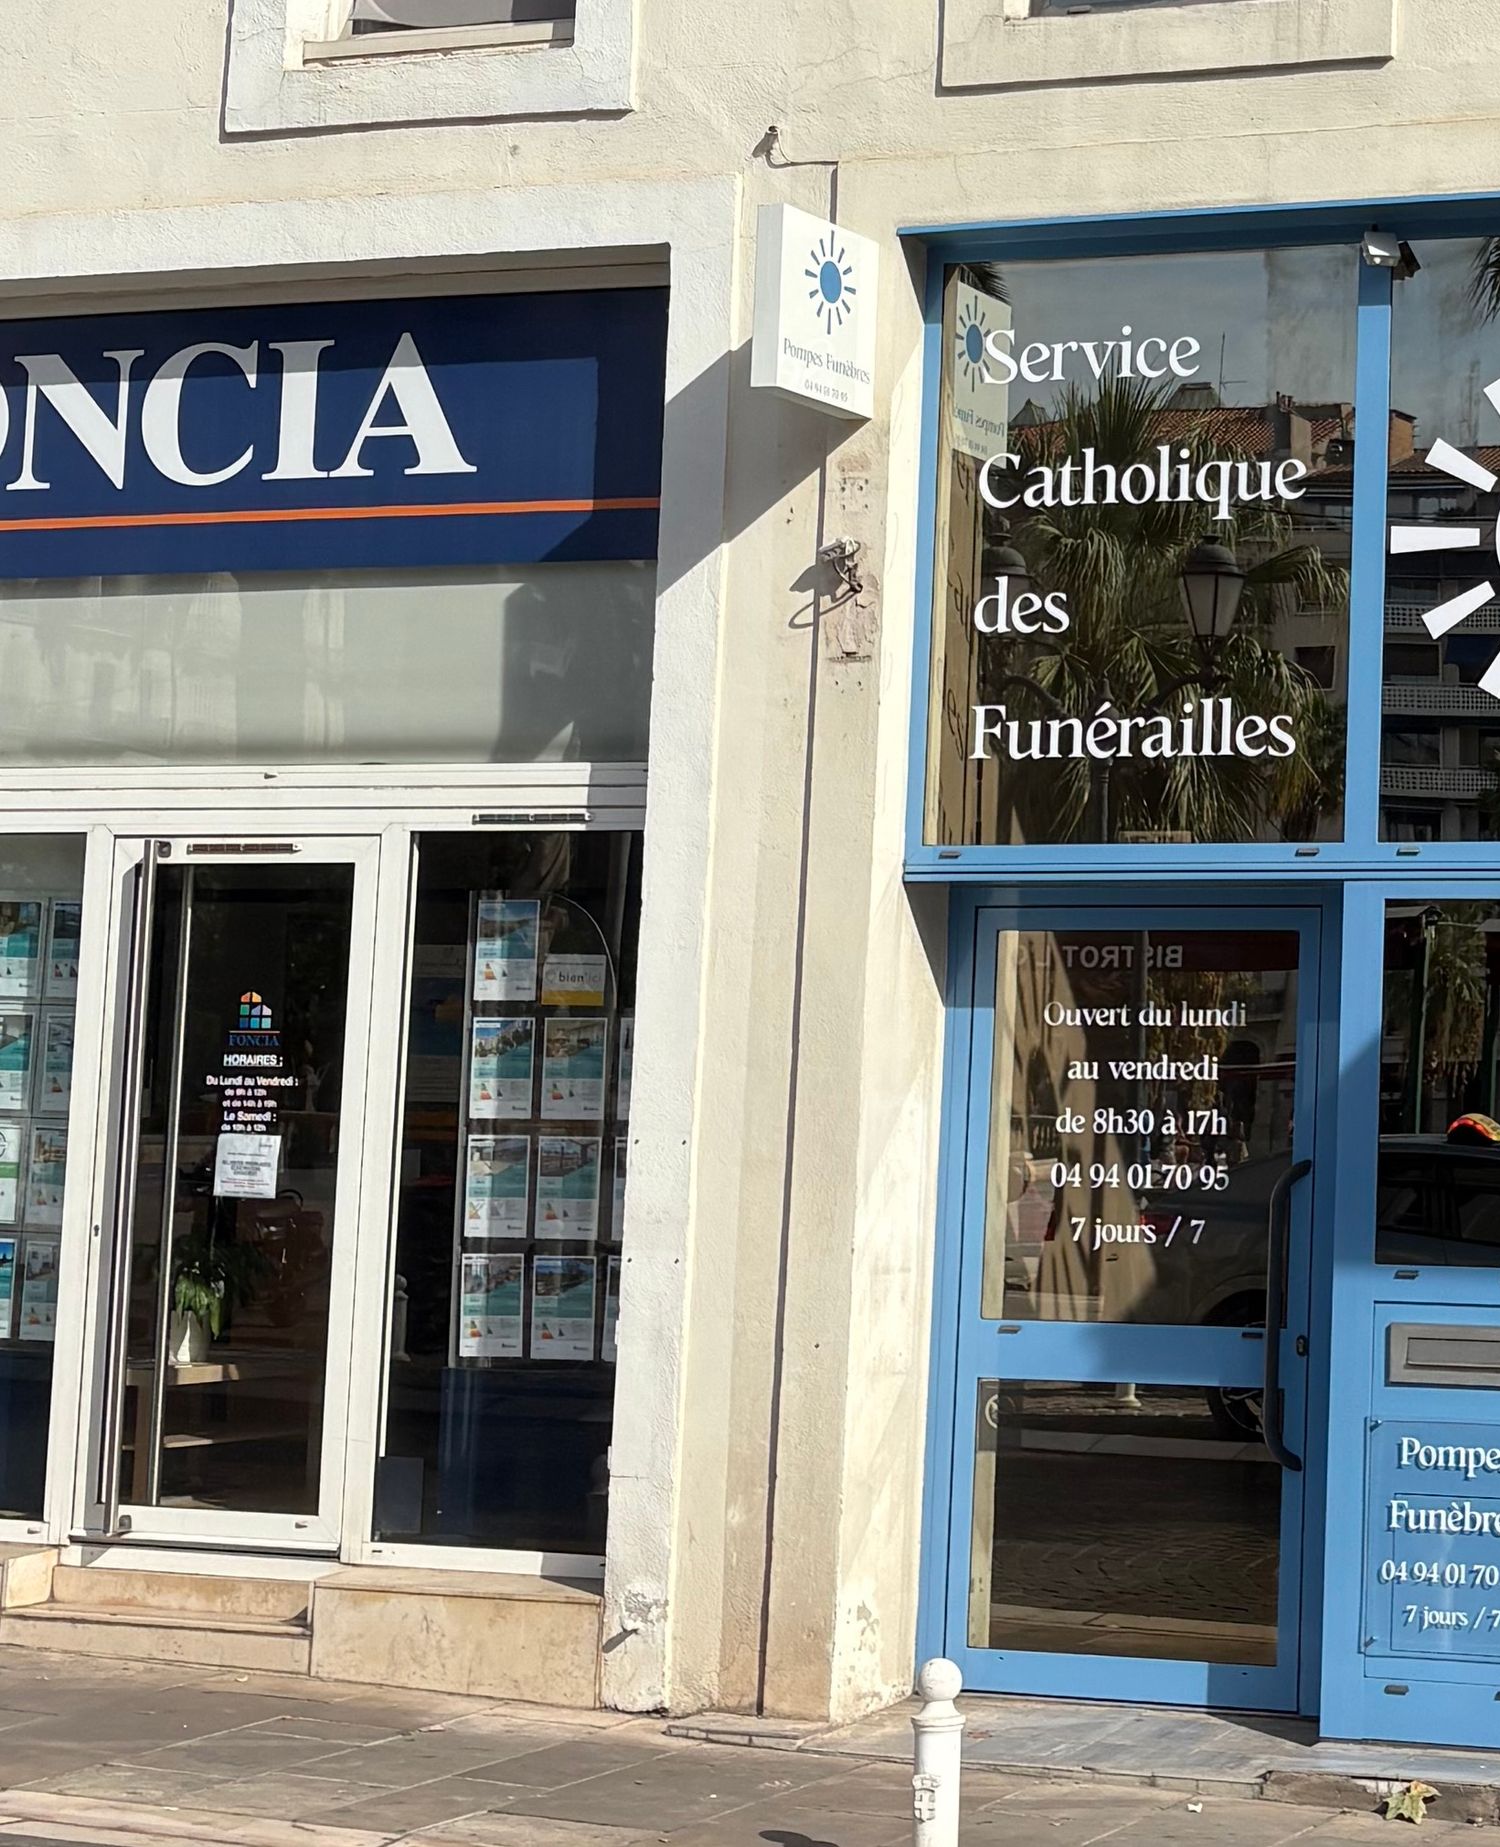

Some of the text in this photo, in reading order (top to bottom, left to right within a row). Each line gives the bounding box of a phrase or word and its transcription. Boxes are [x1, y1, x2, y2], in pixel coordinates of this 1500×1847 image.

[783, 337, 870, 385] Pompes Funèbres
[981, 325, 1201, 385] Service
[0, 333, 477, 490] NCIA
[979, 445, 1307, 520] Catholique
[974, 576, 1070, 634] des
[968, 697, 1297, 760] Funérailles
[1044, 1001, 1246, 1027] Ouvert du lundi
[229, 1035, 279, 1047] FONCIA
[223, 1054, 277, 1067] HORAIRES
[1067, 1054, 1219, 1080] au vendredi
[1055, 1107, 1227, 1135] de 8h30 à 17h
[1050, 1162, 1229, 1191] 04 94 01 70 95
[1070, 1217, 1086, 1242] 7
[1093, 1218, 1157, 1250] jours
[1190, 1219, 1206, 1244] 7
[1381, 1559, 1408, 1581] 04
[1413, 1561, 1440, 1583] 94
[1444, 1563, 1466, 1585] 01
[1472, 1564, 1500, 1586] 70
[1405, 1604, 1418, 1623] 7
[1422, 1605, 1469, 1630] jours
